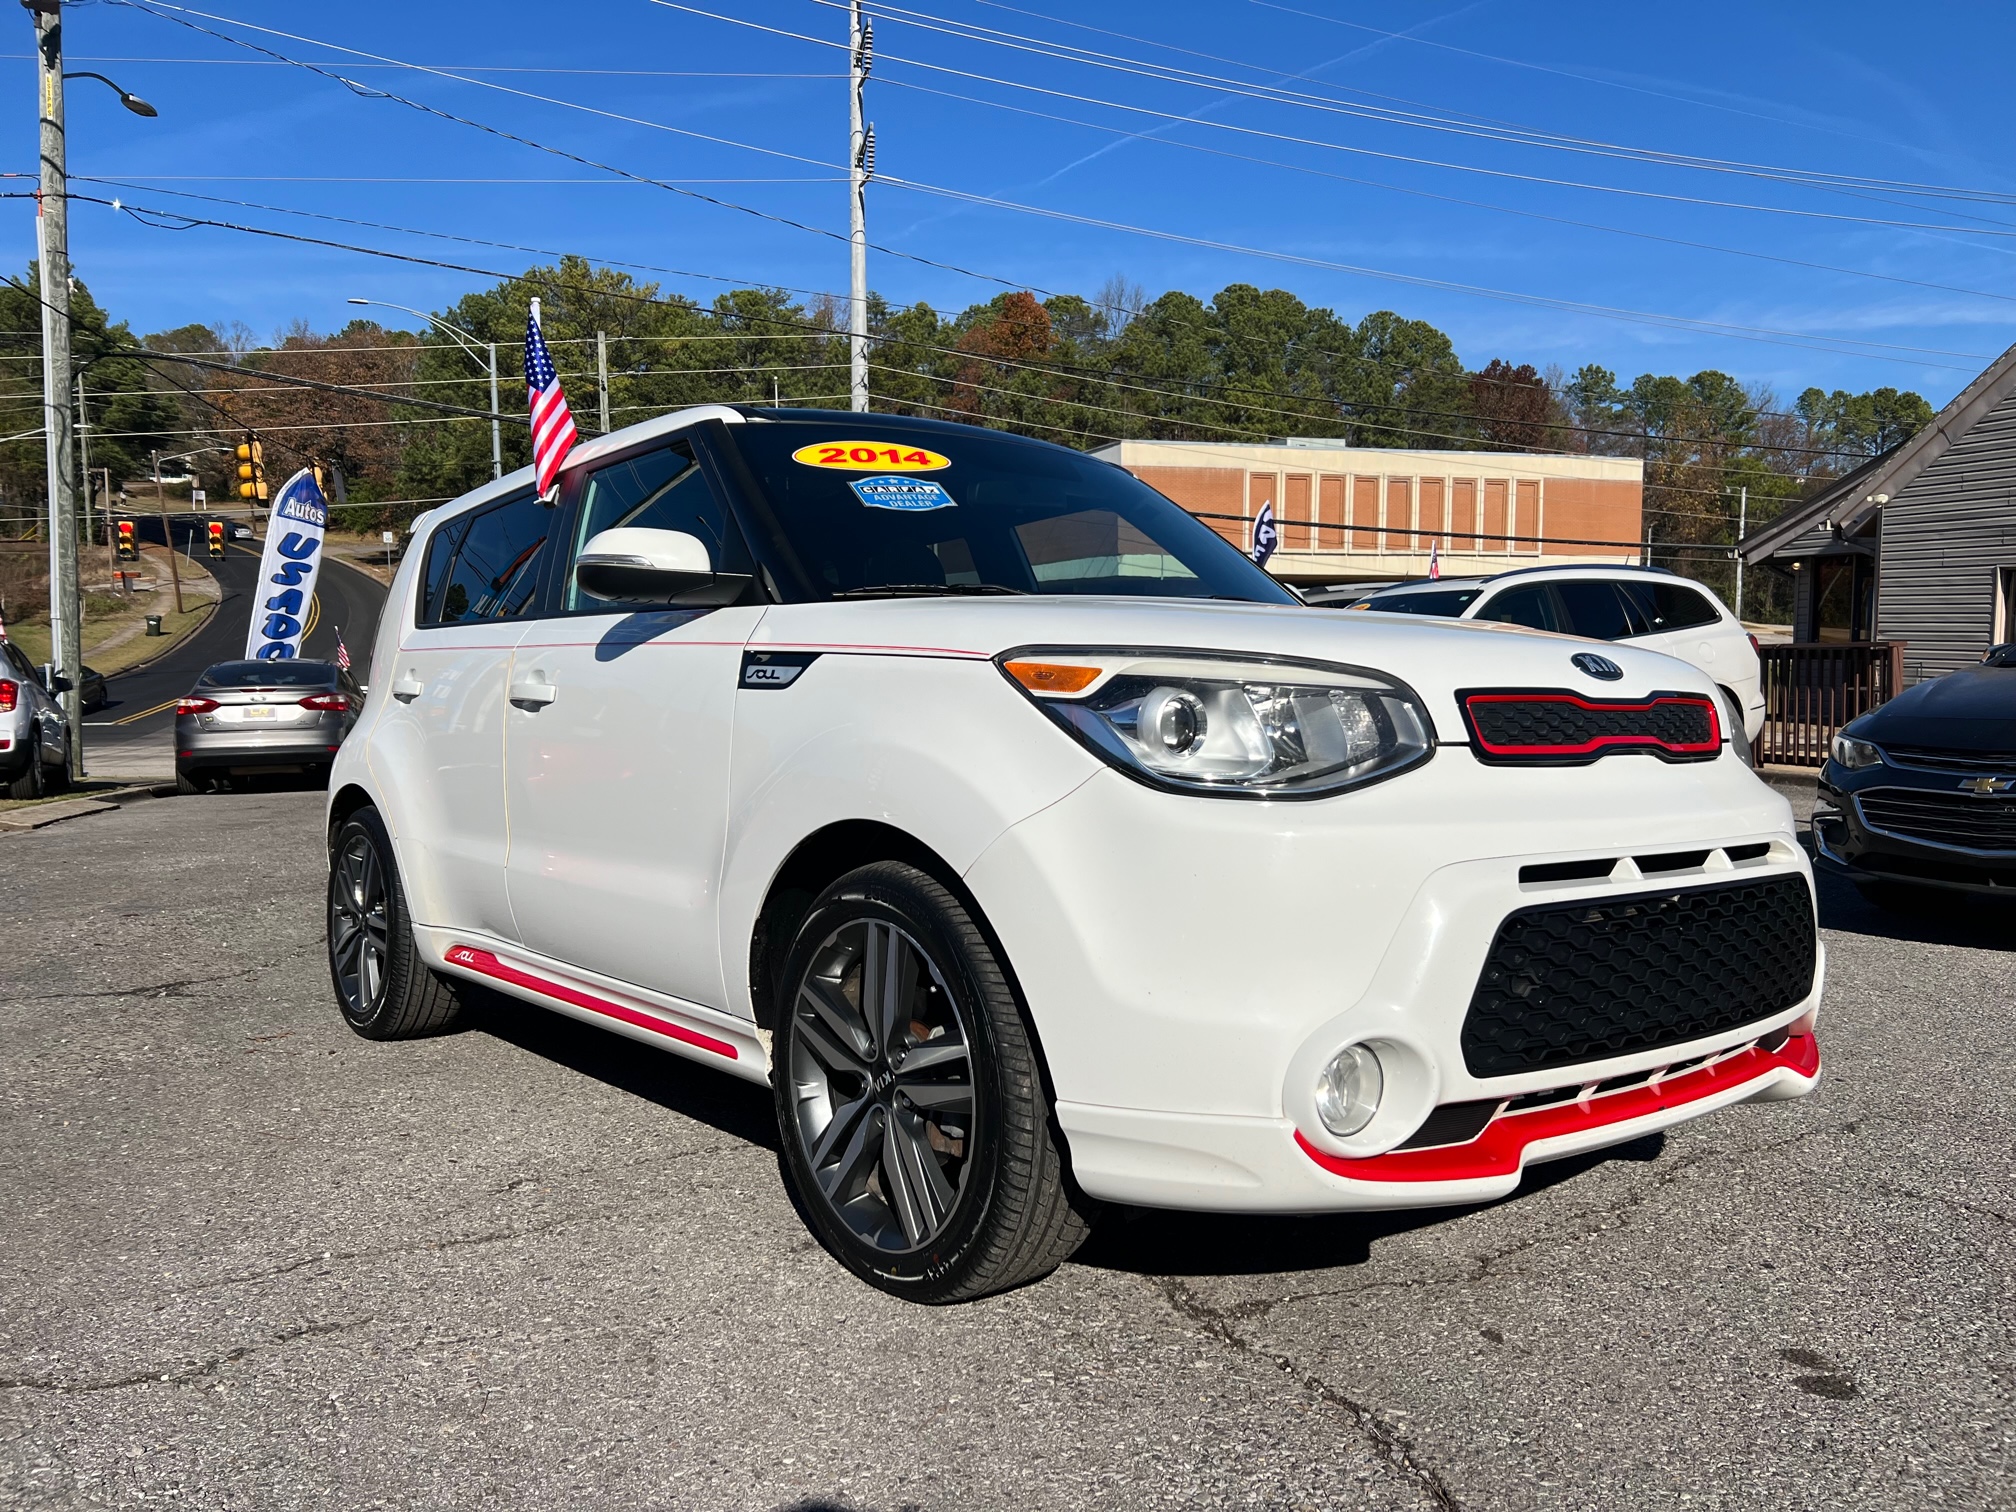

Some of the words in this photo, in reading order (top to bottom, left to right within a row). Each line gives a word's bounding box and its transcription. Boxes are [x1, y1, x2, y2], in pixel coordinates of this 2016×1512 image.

[819, 448, 931, 465] 2014
[862, 486, 940, 494] CARFAX
[283, 497, 325, 526] Autos
